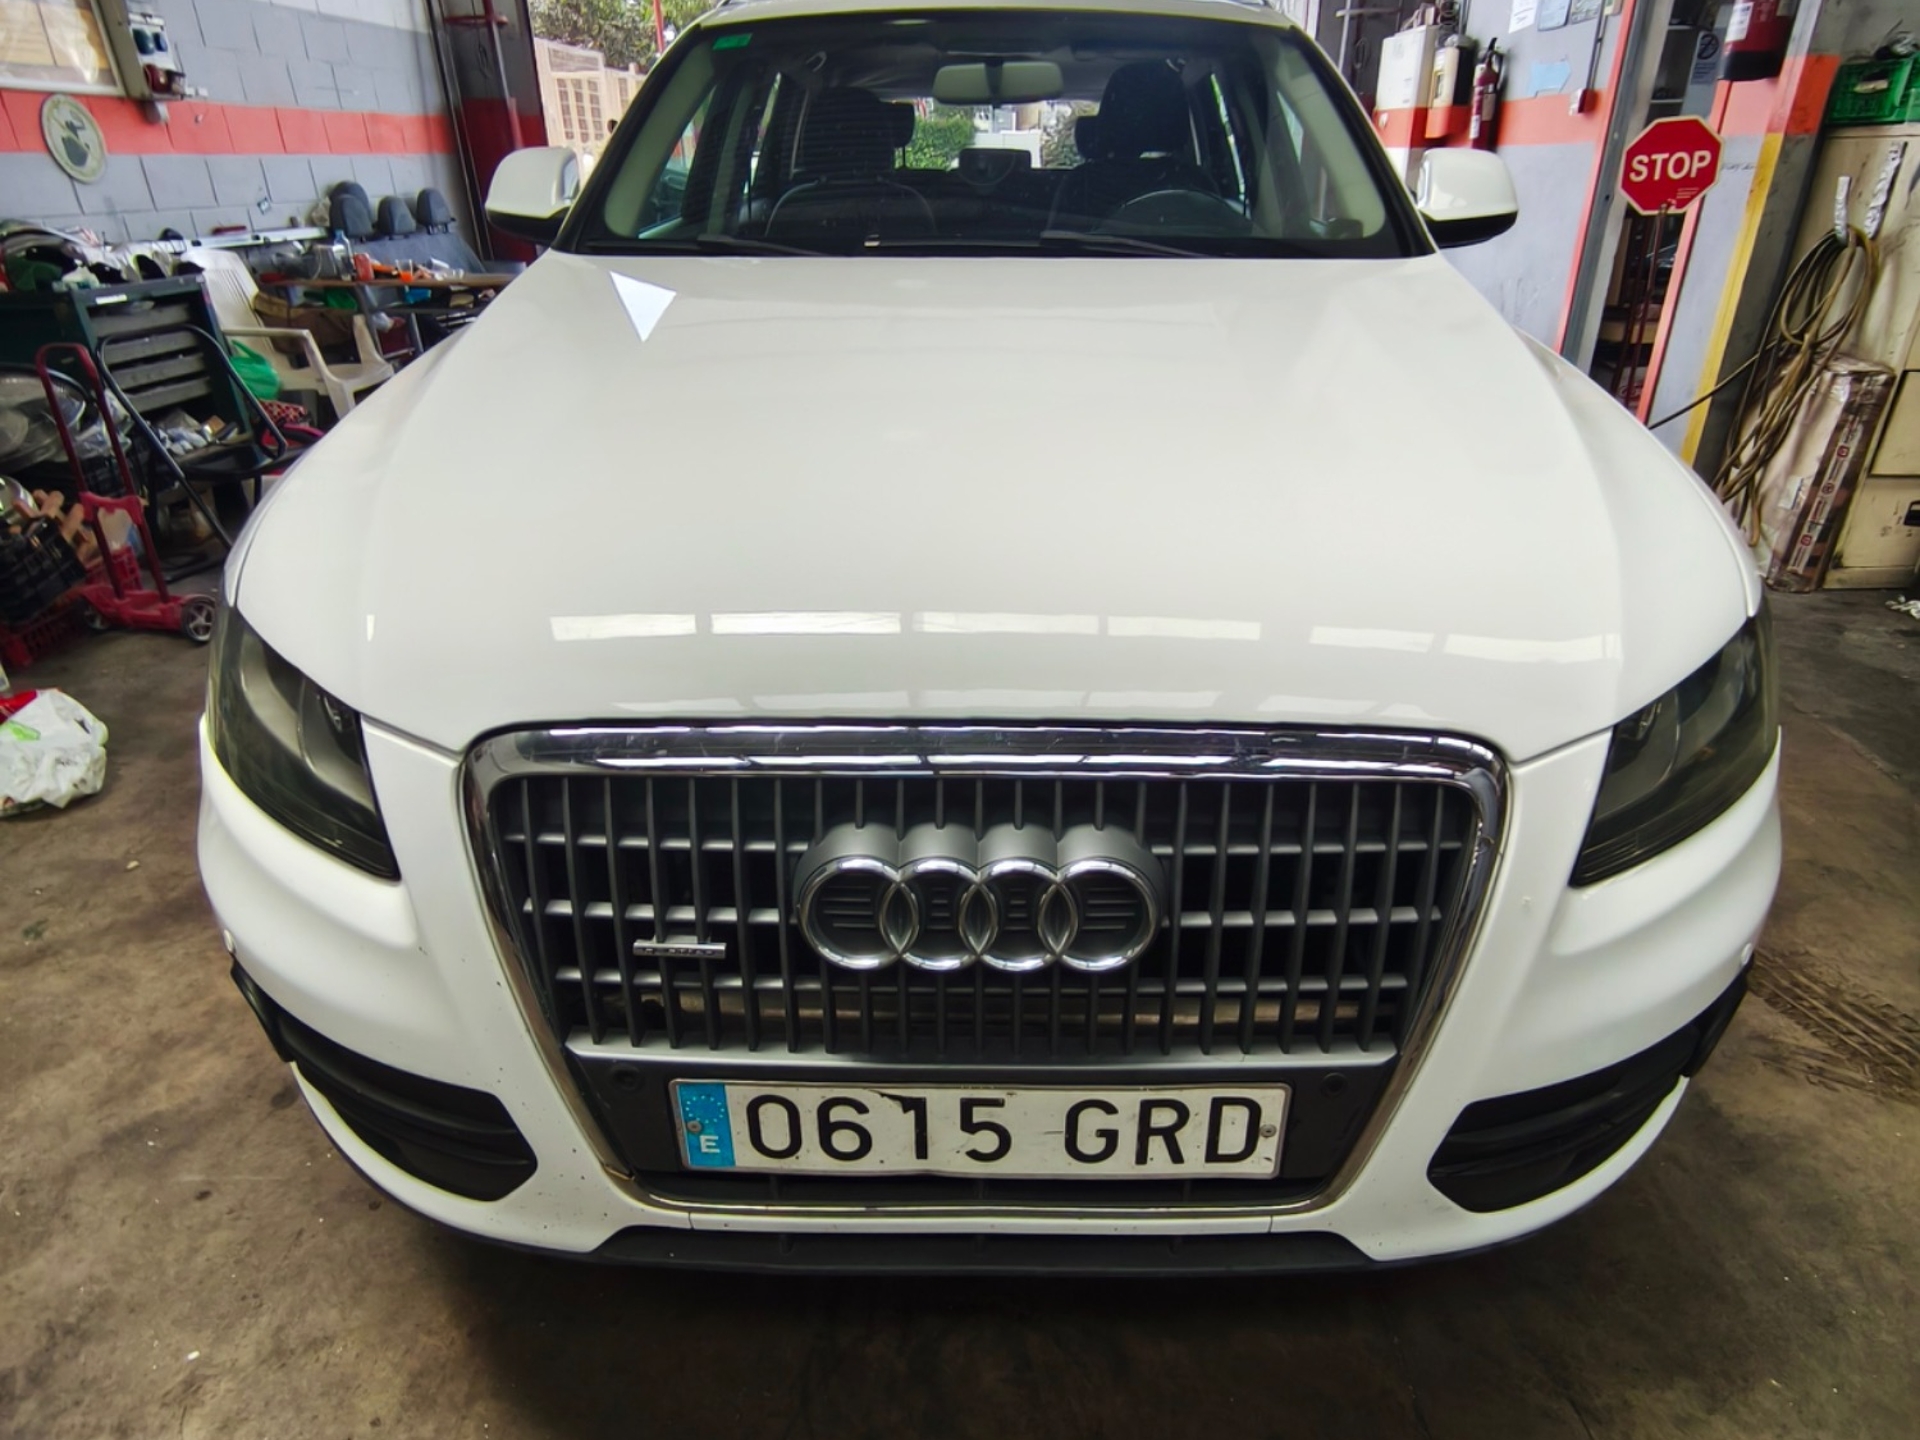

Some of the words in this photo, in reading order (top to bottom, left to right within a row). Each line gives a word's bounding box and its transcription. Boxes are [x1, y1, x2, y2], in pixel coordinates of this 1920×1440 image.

[1629, 150, 1712, 183] STOP
[699, 1135, 721, 1154] E
[745, 1093, 1013, 1164] 0615
[1063, 1095, 1264, 1166] GRD
